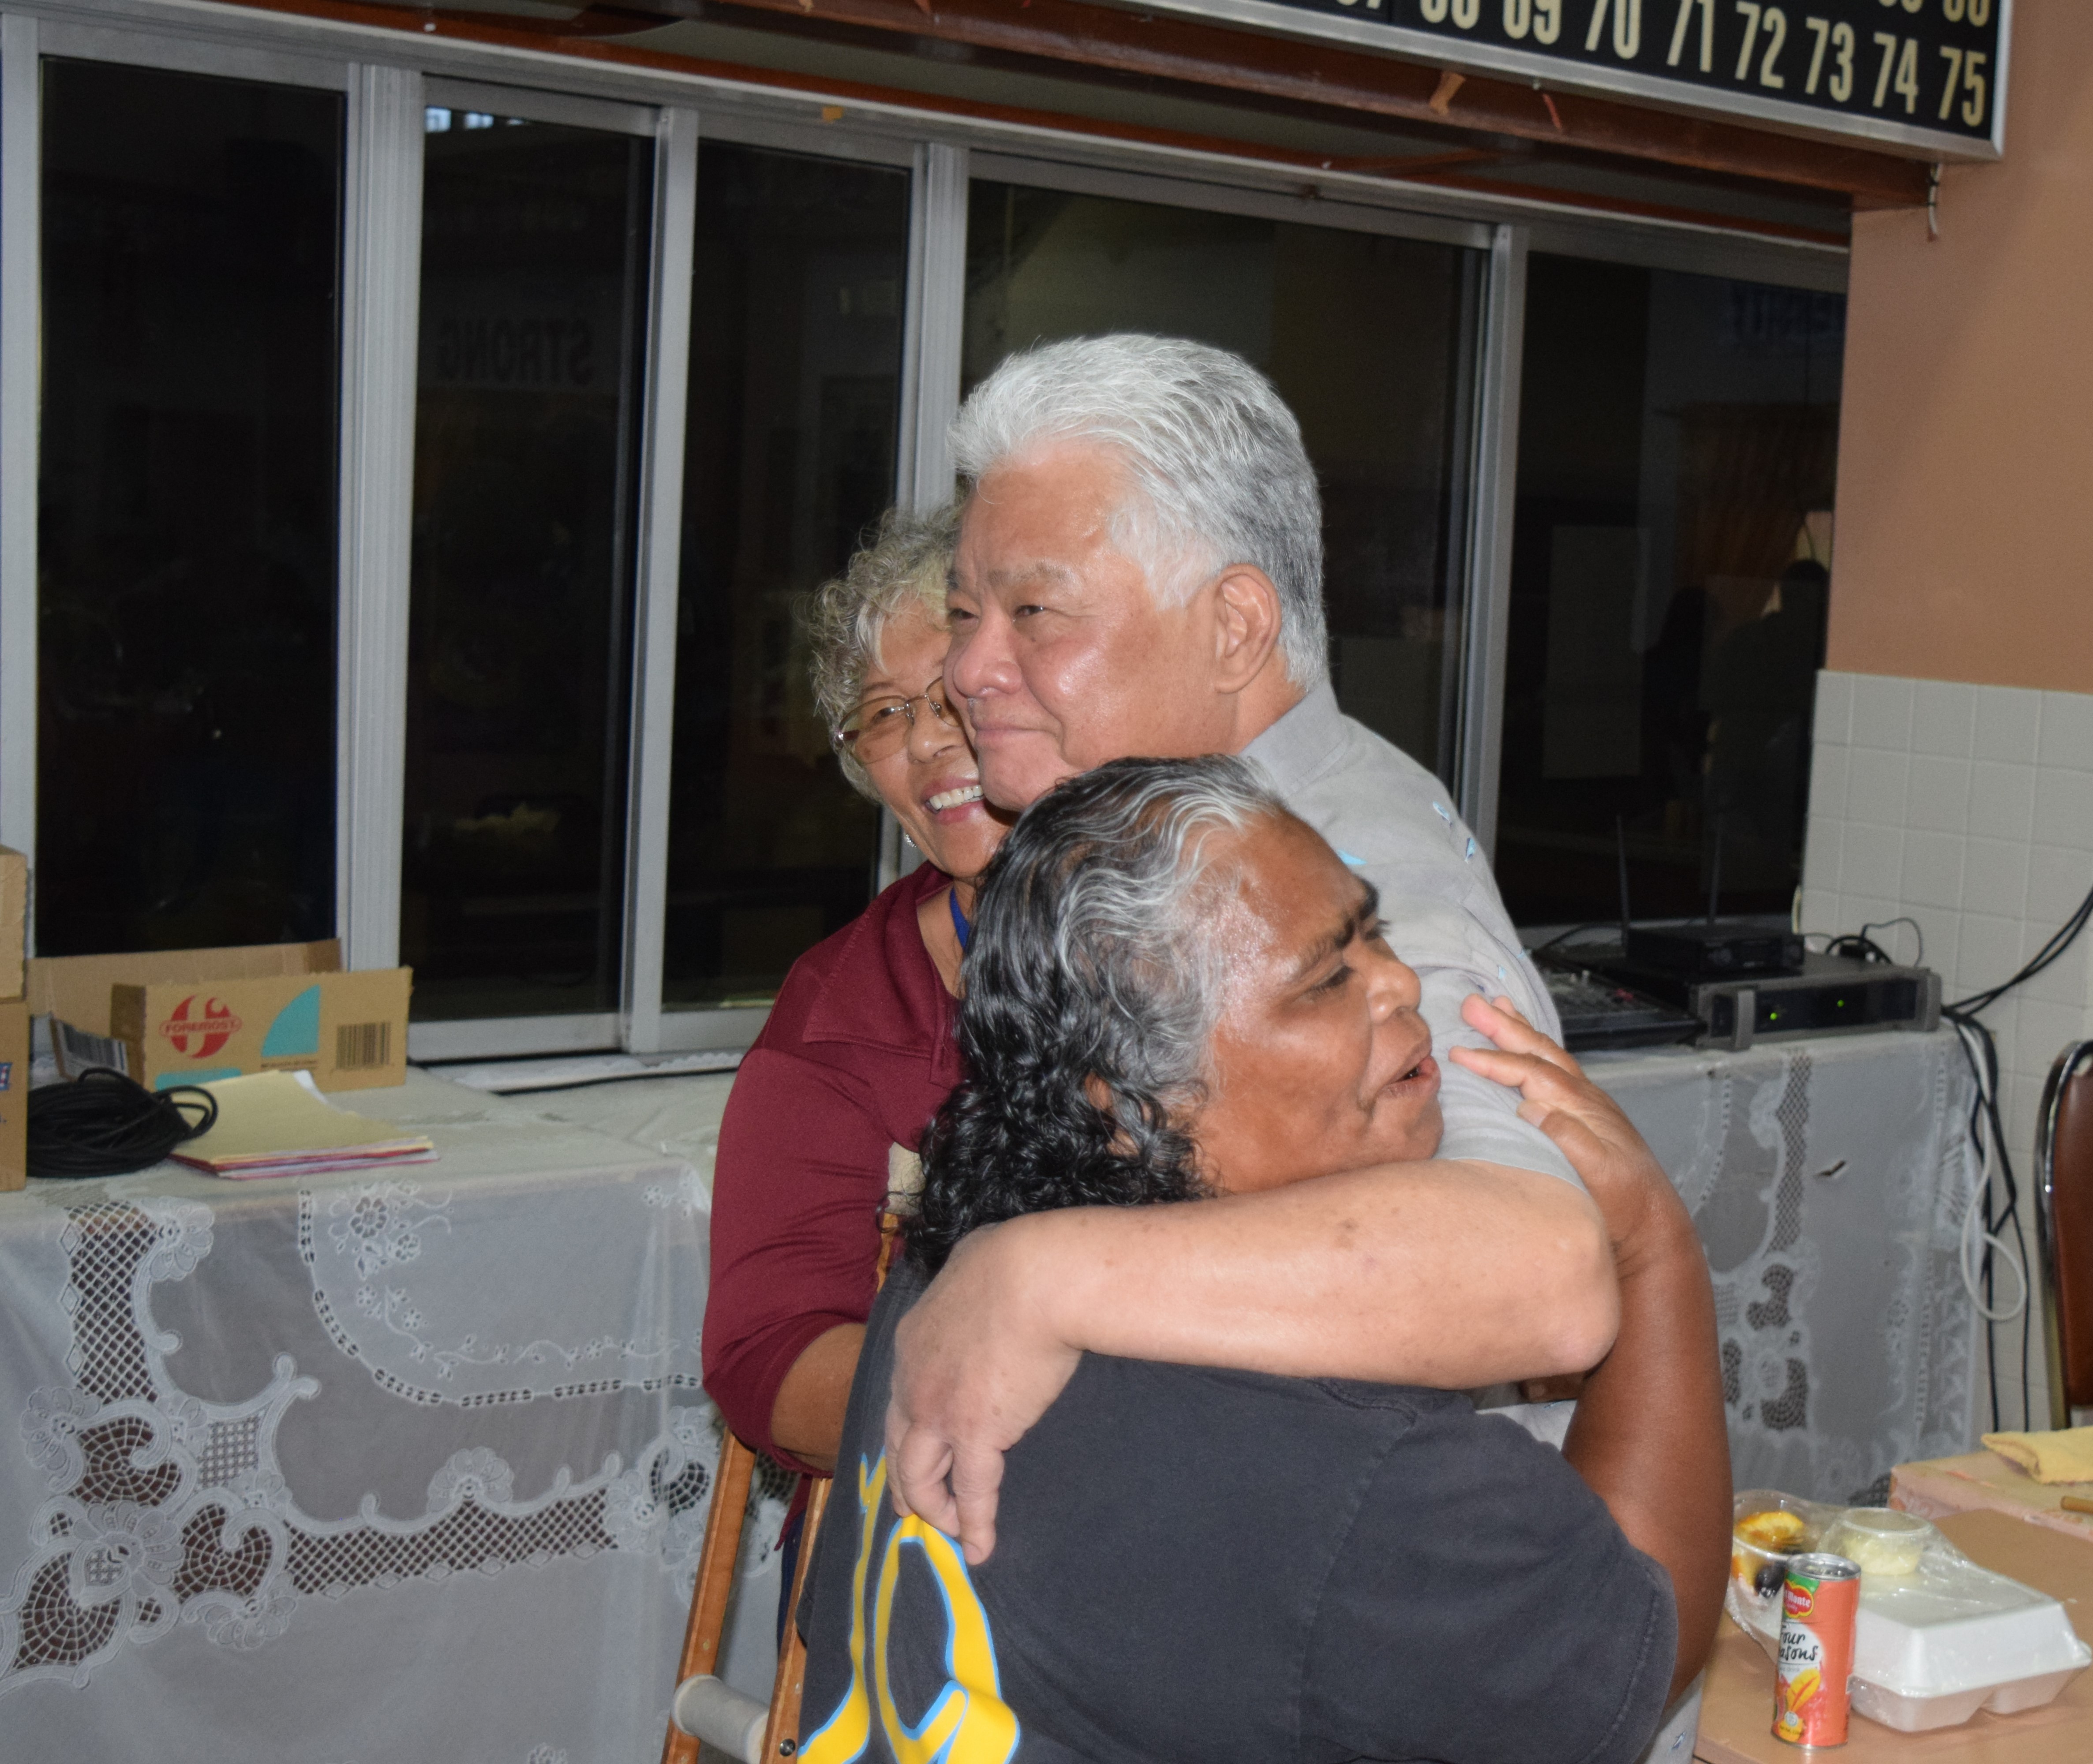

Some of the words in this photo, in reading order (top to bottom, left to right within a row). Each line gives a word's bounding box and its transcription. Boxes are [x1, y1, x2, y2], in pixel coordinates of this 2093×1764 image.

[1667, 0, 1714, 72] 71
[1735, 1, 1786, 88] 72
[1805, 17, 1854, 102] 73
[1873, 33, 1918, 113] 74
[1939, 46, 1987, 126] 75
[165, 1019, 236, 1033] FOREMOST
